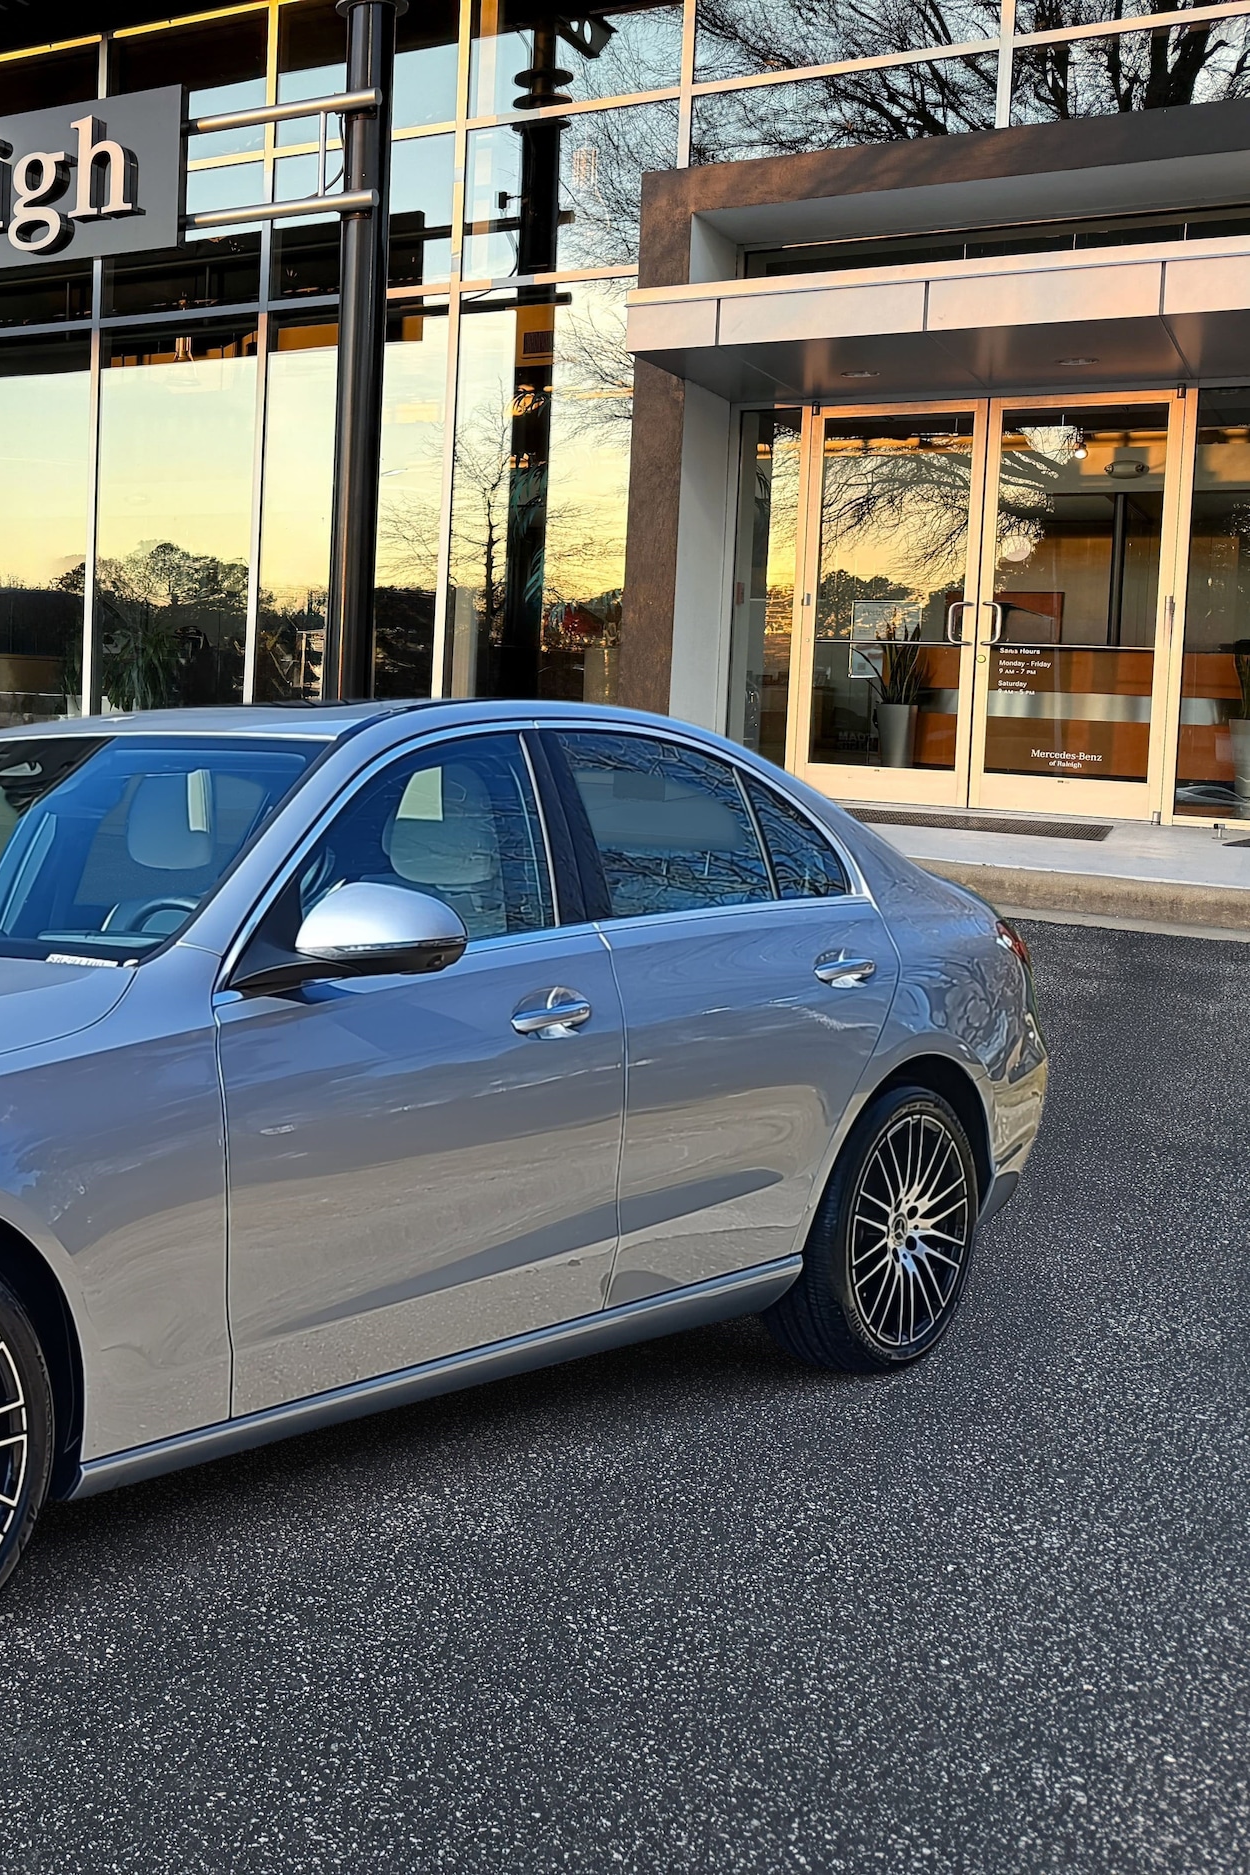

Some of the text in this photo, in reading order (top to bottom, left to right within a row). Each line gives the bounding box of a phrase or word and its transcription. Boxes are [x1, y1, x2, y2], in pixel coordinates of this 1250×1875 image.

[998, 660, 1026, 668] Monday
[1030, 660, 1052, 669] Friday
[997, 680, 1028, 688] Saturday
[1030, 748, 1103, 762] Mercedes-Benz
[1056, 760, 1083, 769] Raleigh
